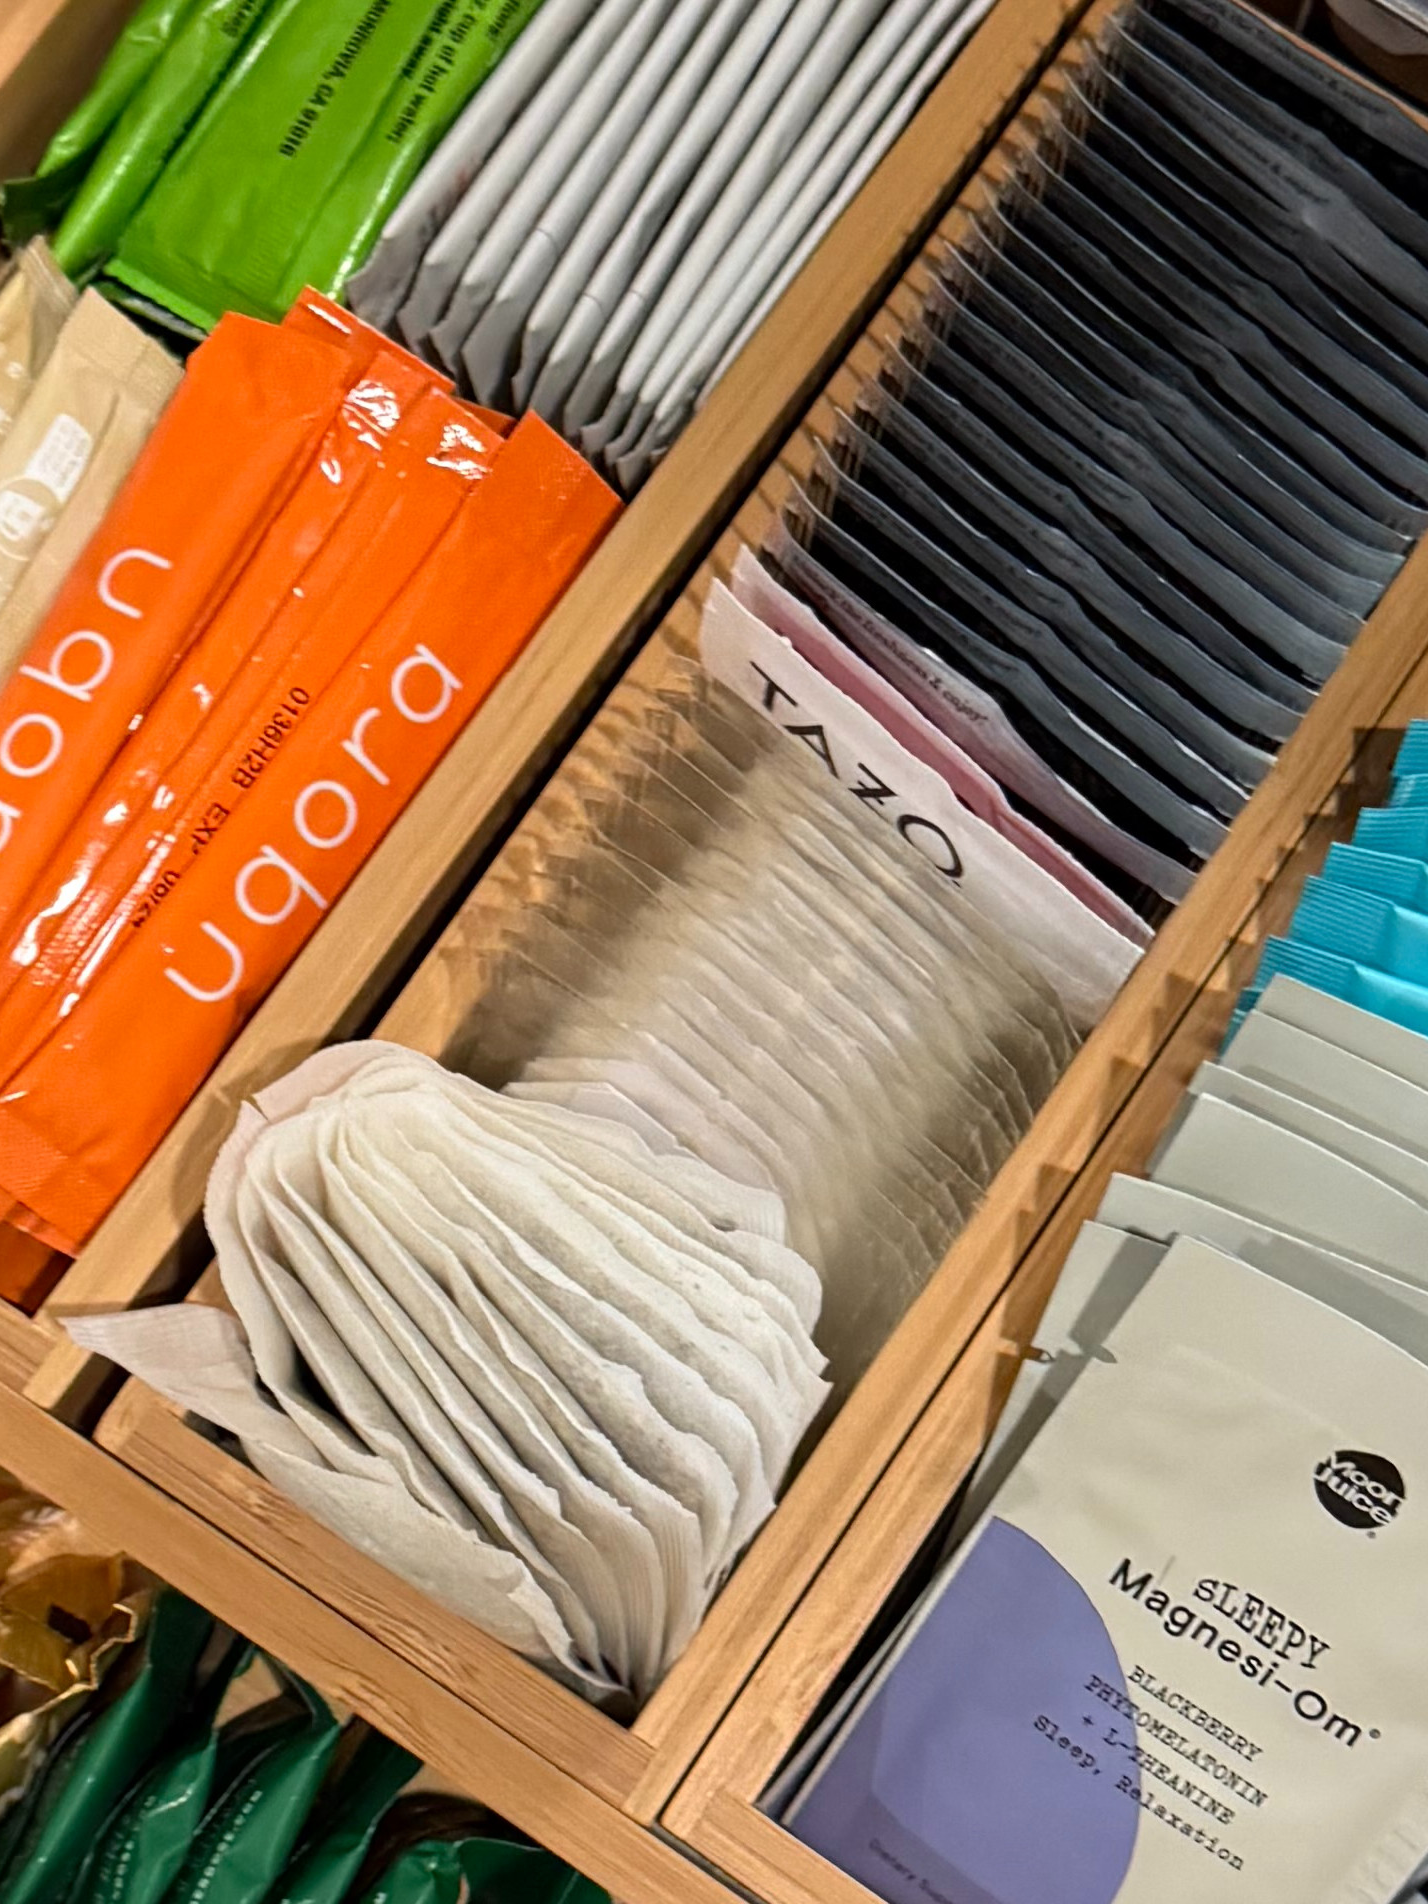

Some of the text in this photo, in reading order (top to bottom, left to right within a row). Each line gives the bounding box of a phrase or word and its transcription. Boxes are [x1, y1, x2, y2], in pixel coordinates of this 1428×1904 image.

[444, 9, 478, 47] cup
[416, 61, 449, 97] hot
[228, 681, 313, 794] 0136H2B
[165, 643, 463, 1003] uqora
[1306, 1461, 1401, 1526] Juice
[1322, 1453, 1408, 1510] Moon
[1101, 1558, 1375, 1745] Magnesi-Om
[1188, 1569, 1331, 1673] SLEEPY
[1076, 1675, 1276, 1807] PHYTOMELATONIN
[1122, 1665, 1268, 1763] BLACKBERRY
[1026, 1714, 1251, 1871] Sleep, Relaxation
[1097, 1728, 1241, 1825] L-THEANINE
